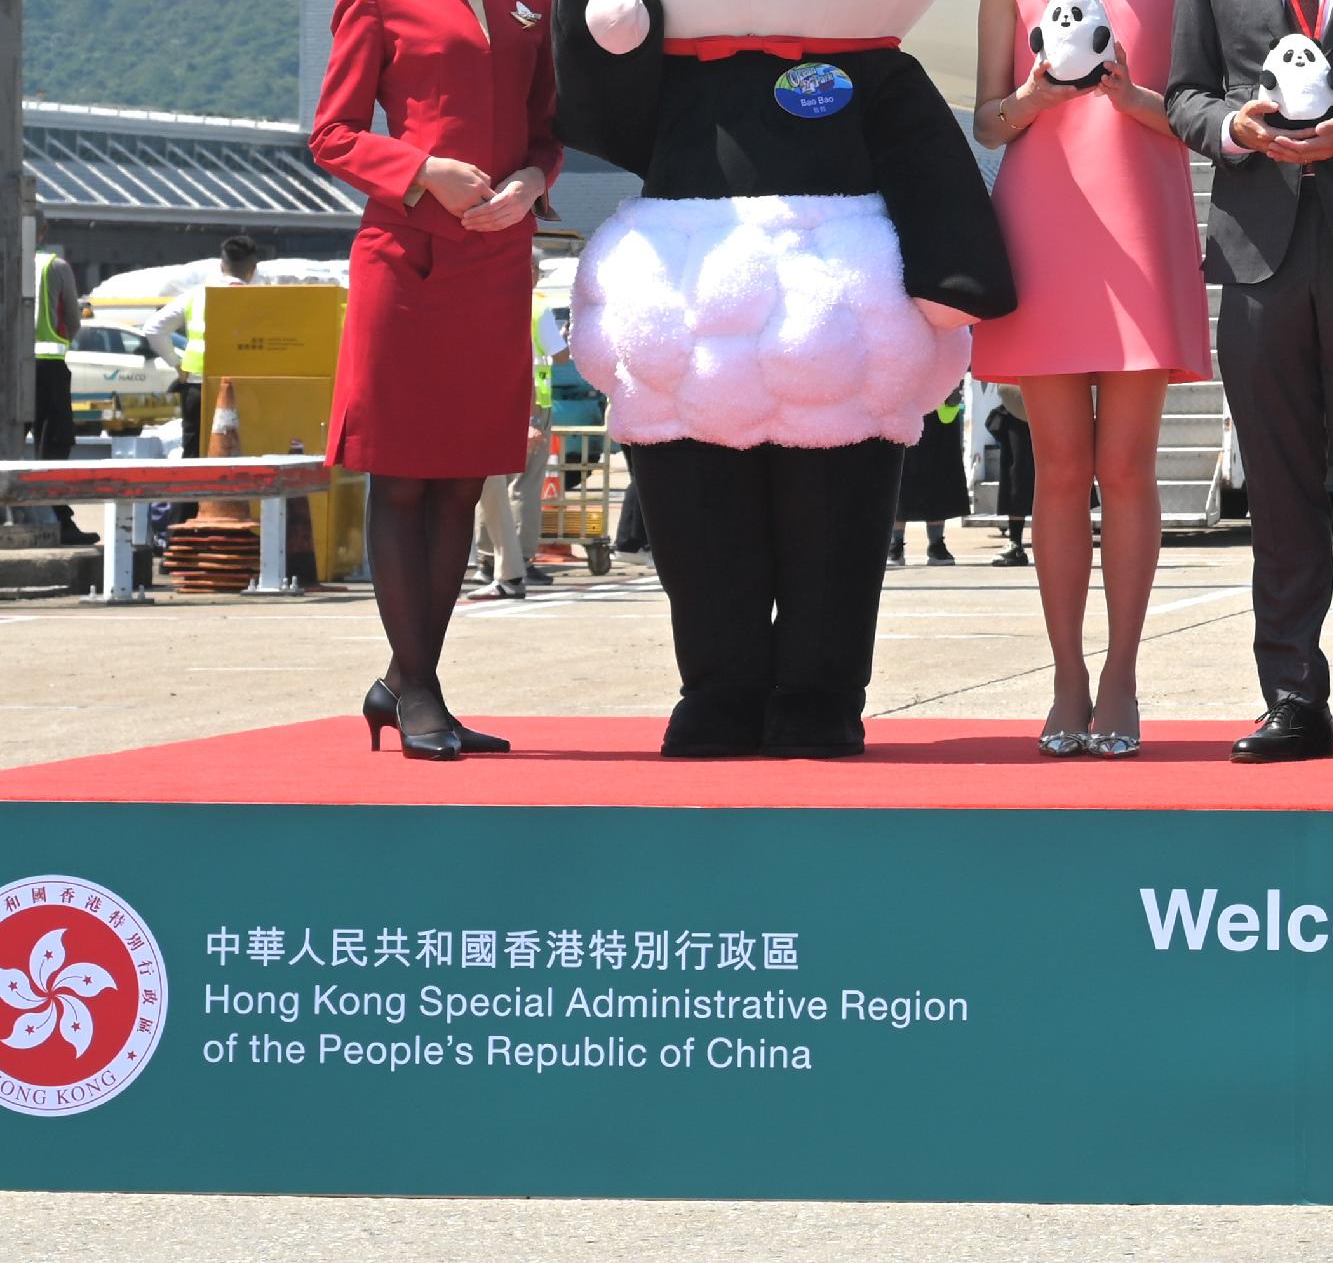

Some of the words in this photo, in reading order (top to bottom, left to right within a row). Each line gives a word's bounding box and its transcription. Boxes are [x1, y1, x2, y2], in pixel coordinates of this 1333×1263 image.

[801, 98, 817, 107] Bao
[818, 96, 834, 105] Bao
[206, 925, 800, 972] 中華人民共和國香港特別行政區
[205, 984, 299, 1023] Hong
[314, 984, 406, 1024] Kong
[419, 985, 553, 1024] Special
[565, 987, 827, 1022] Administrative
[841, 989, 969, 1029] Region
[203, 1033, 239, 1064] of
[249, 1033, 305, 1066] the
[487, 1035, 647, 1074] Republic
[660, 1037, 695, 1069] of
[706, 1037, 812, 1070] China
[0, 1075, 46, 1105] ONG
[56, 1070, 116, 1105] KONG
